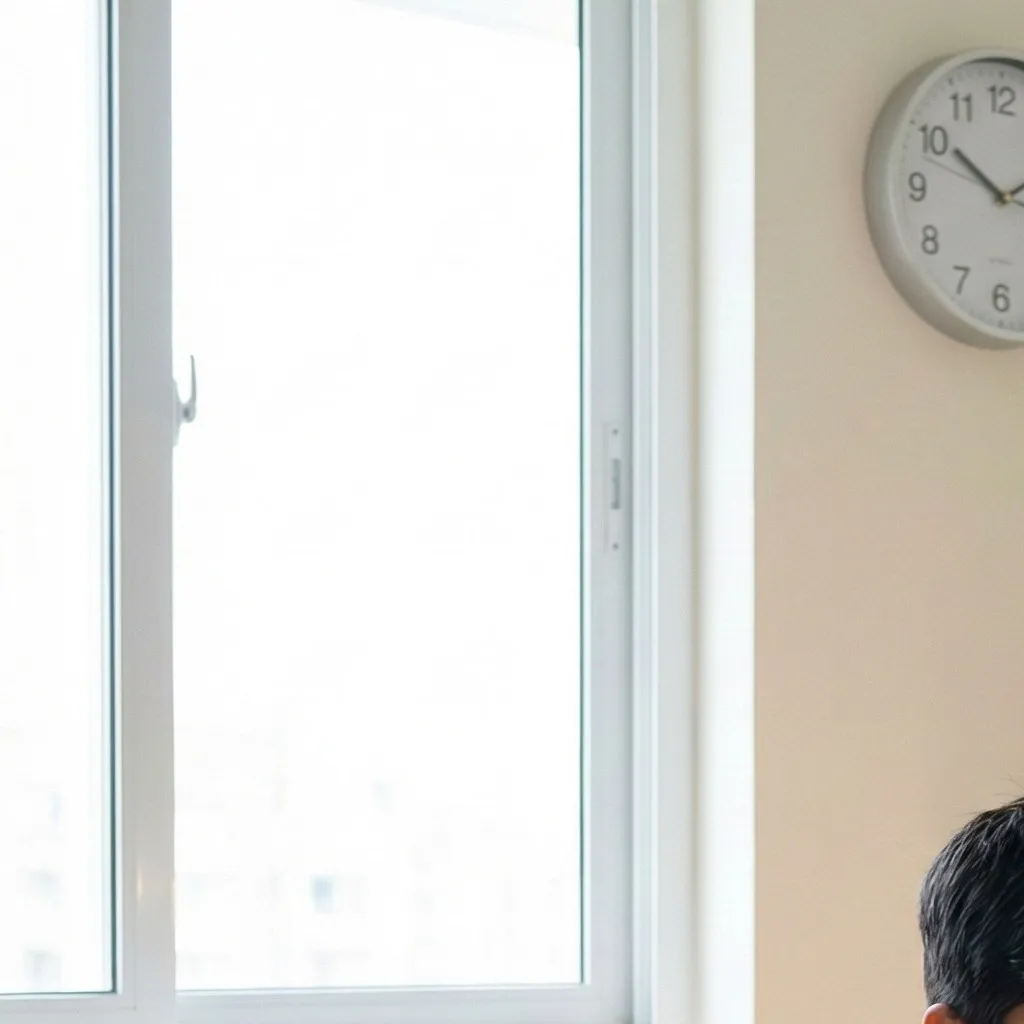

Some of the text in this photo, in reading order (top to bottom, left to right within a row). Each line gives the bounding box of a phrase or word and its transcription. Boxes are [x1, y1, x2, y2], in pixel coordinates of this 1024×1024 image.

[949, 92, 973, 122] 11
[986, 85, 1016, 117] 12
[918, 124, 948, 156] 10
[908, 172, 927, 202] 9
[921, 224, 939, 255] 8
[952, 265, 971, 295] 7
[992, 283, 1011, 313] 6
